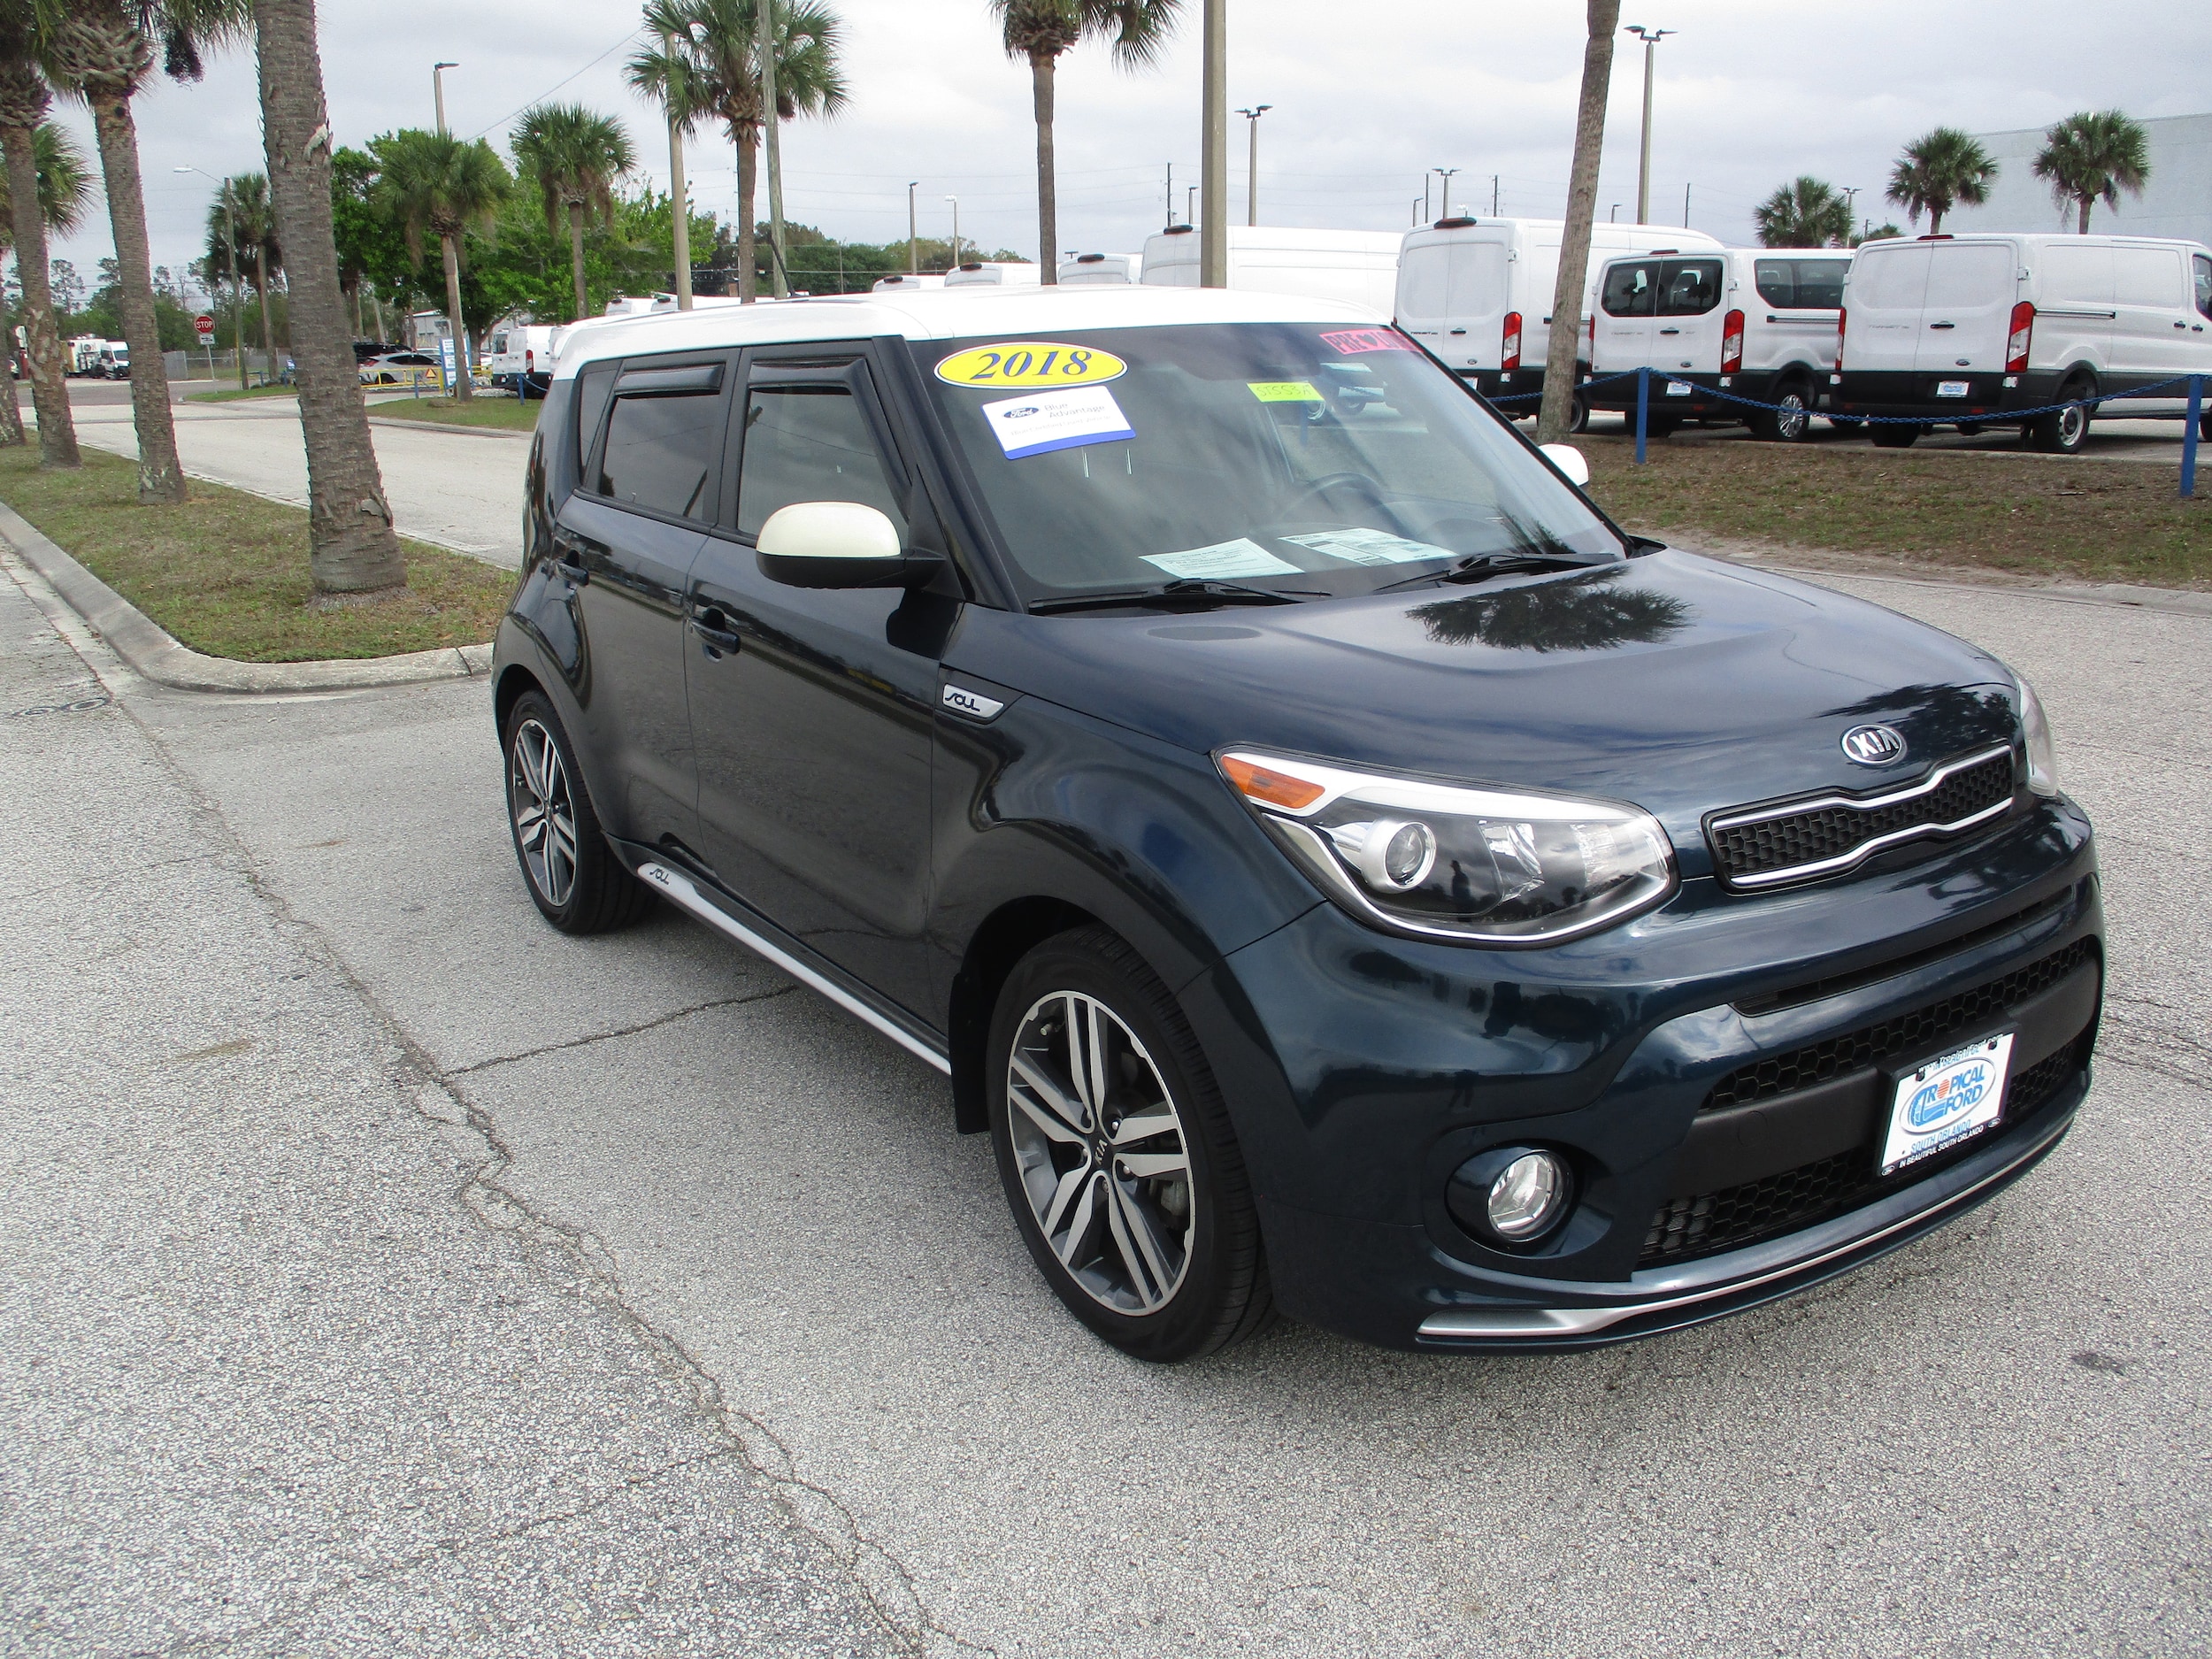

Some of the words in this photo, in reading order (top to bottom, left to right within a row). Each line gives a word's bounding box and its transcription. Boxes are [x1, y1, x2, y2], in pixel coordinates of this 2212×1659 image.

[1324, 332, 1368, 352] PRE
[969, 350, 1092, 380] 2018
[1010, 408, 1035, 419] Ford
[1044, 402, 1068, 411] Blue
[1049, 404, 1105, 419] Advantage
[1849, 729, 1899, 757] KIA
[1918, 1064, 1985, 1102] TROPICAL
[1946, 1084, 1984, 1115] FORD
[1899, 1160, 1906, 1169] IN
[1906, 1147, 1937, 1165] BEAUTIFUL
[1938, 1138, 1957, 1152] SOUTH
[1957, 1125, 1985, 1142] ORLANDO
[1911, 1133, 1936, 1154] SOUTH
[1937, 1118, 1971, 1142] ORLANDO
[1094, 1139, 1108, 1165] KIA
